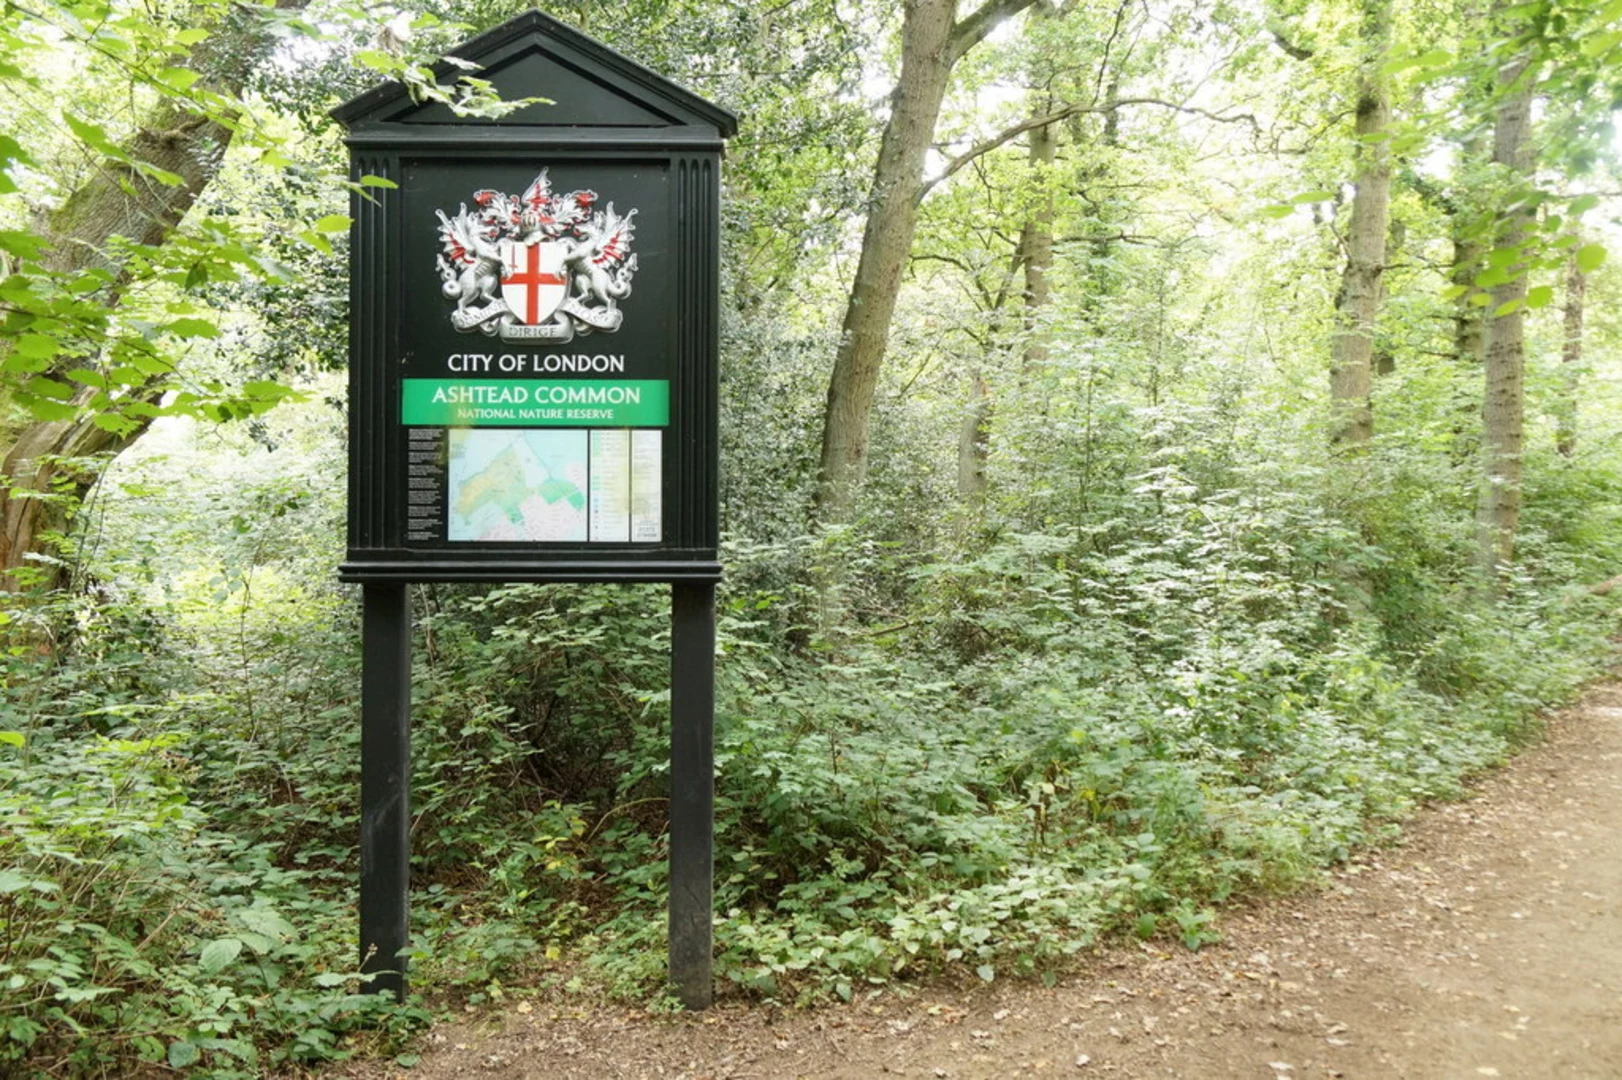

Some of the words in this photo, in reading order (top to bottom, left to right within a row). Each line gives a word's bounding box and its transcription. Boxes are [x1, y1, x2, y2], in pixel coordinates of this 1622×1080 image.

[509, 327, 557, 337] DIRIGE
[448, 354, 493, 372] CITY
[499, 354, 527, 372] OF
[533, 354, 625, 373] LONDON
[432, 386, 528, 404] ASHTEAD
[534, 387, 641, 405] COMMON
[458, 408, 516, 419] NATIONAL
[519, 409, 564, 419] NATURE
[567, 409, 614, 419] RESERVE
